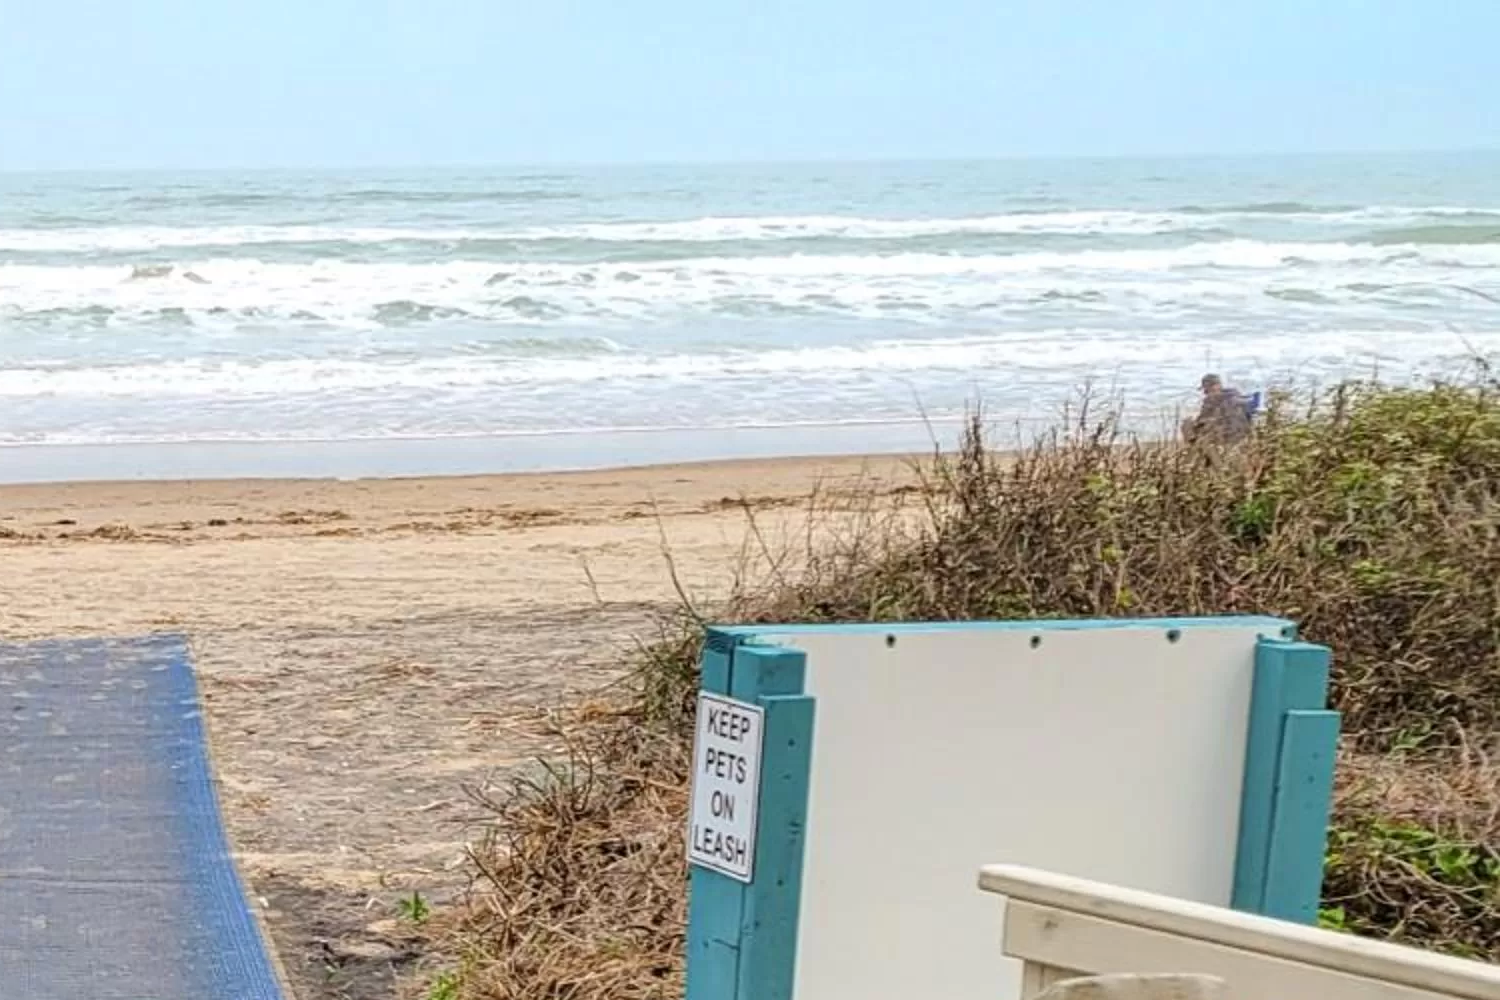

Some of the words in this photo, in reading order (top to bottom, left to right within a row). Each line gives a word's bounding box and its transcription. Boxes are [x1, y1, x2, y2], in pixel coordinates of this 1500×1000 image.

[707, 707, 749, 743] KEEP
[706, 748, 747, 784] PETS
[711, 791, 734, 821] ON
[694, 824, 747, 867] LEASH
